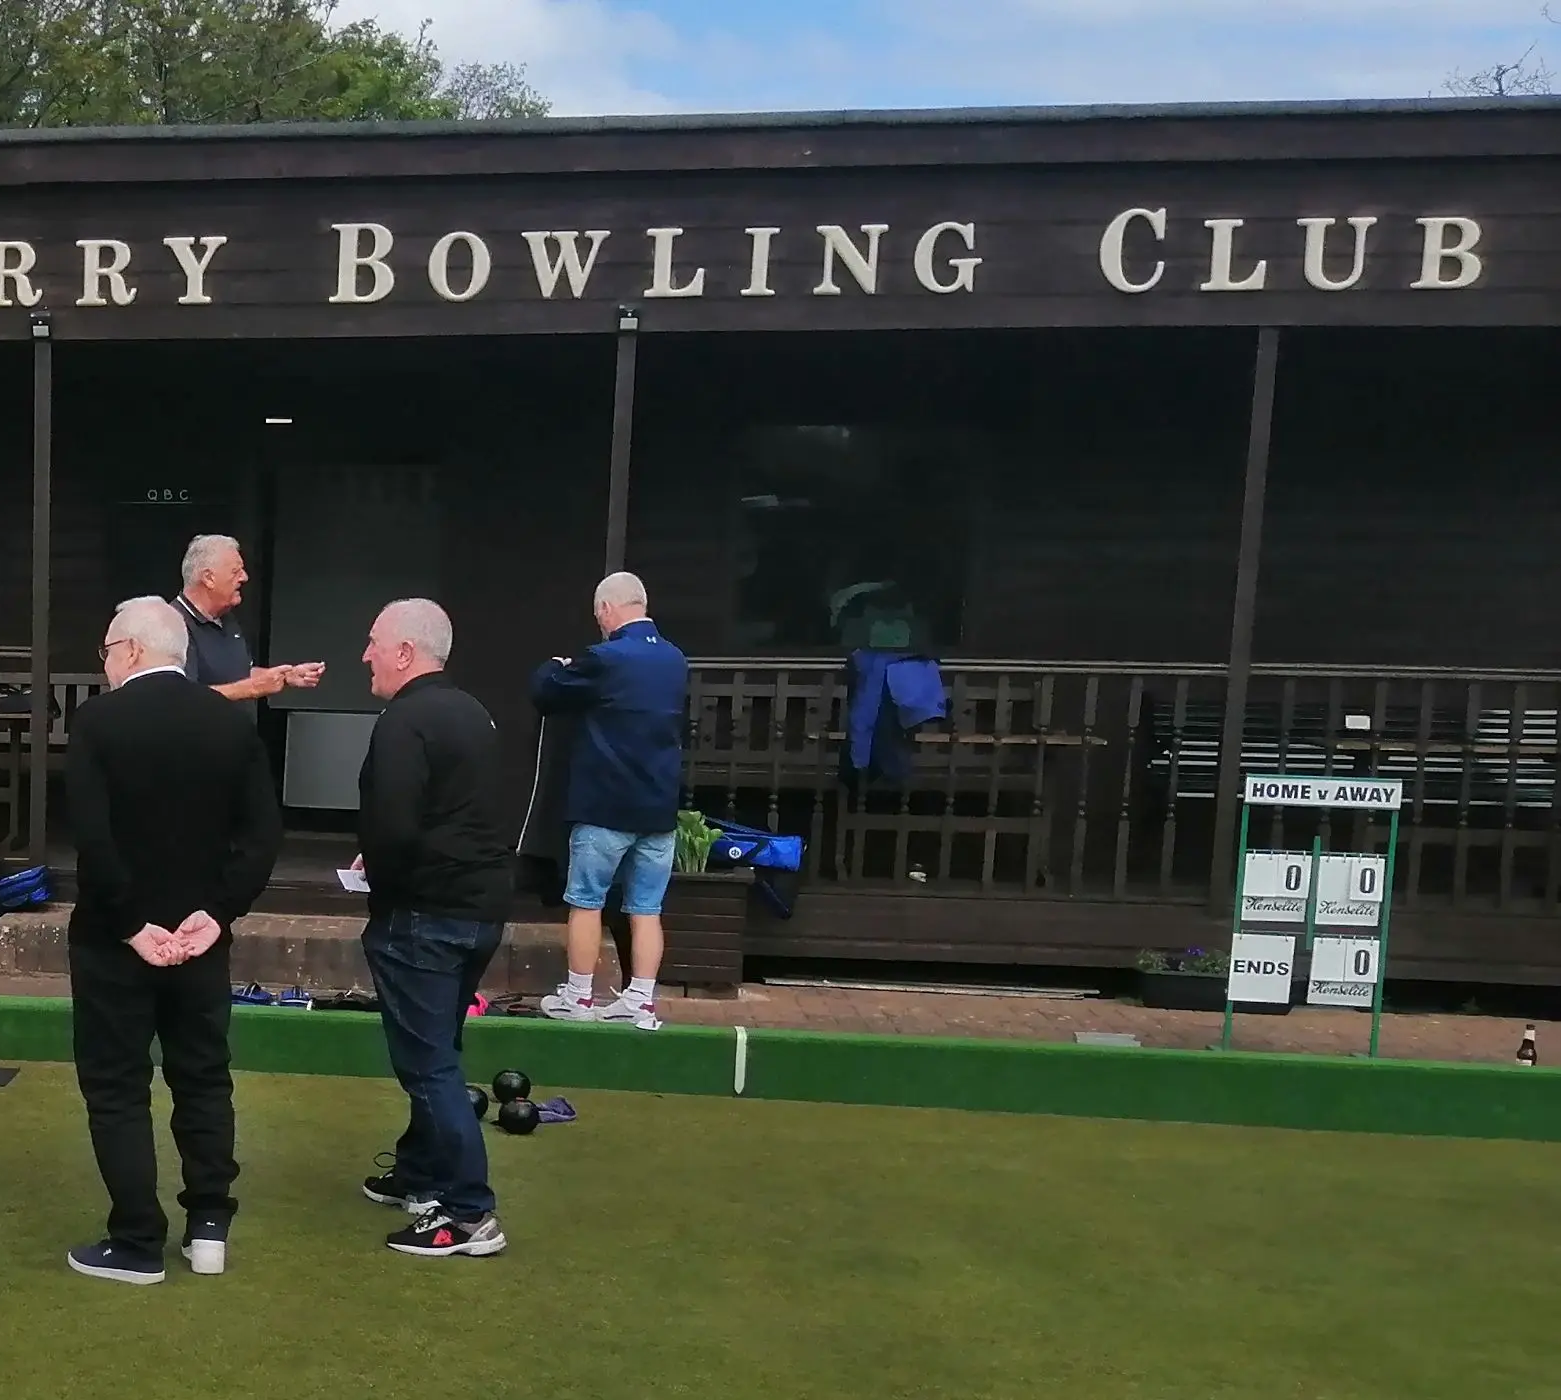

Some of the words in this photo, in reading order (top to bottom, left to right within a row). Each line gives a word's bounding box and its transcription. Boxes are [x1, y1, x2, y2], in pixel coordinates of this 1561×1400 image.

[329, 220, 983, 305] BOWLING
[1097, 207, 1483, 294] CLUB
[1251, 782, 1312, 801] HOME
[1334, 786, 1396, 803] AWAY
[1285, 864, 1302, 891] 0
[1359, 867, 1376, 894] 0
[1244, 896, 1303, 913] Henselite
[1318, 900, 1376, 917] Henselite
[1233, 959, 1289, 976] ENDS
[1354, 949, 1371, 976] 0
[1311, 981, 1369, 997] Henselite
